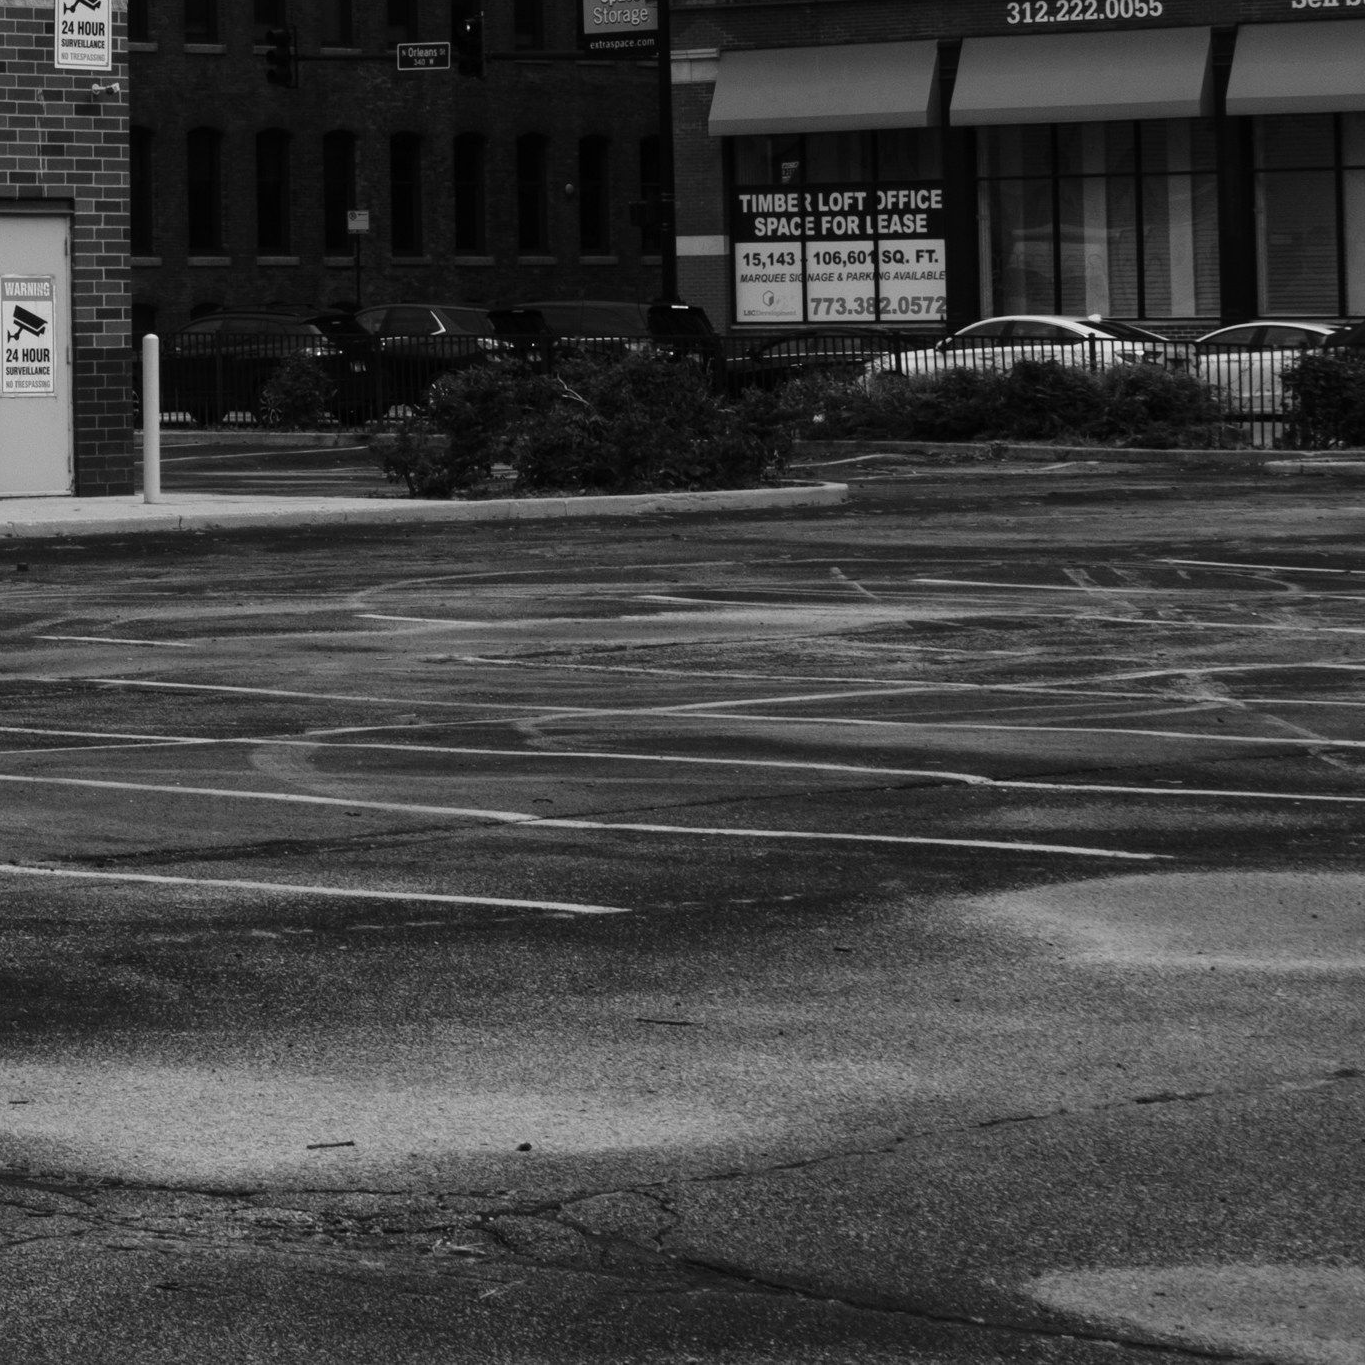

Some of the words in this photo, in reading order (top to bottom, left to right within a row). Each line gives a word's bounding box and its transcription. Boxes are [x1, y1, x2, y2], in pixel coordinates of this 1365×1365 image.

[594, 7, 648, 25] Storage
[62, 20, 74, 34] 24
[78, 21, 106, 36] HOUR
[61, 38, 105, 49] SURVEILLANCE
[590, 38, 655, 50] extraspace.com
[61, 52, 68, 60] NO
[70, 53, 106, 62] TRESPASSING
[408, 47, 438, 58] Orleans
[818, 192, 867, 212] LOFT
[877, 190, 942, 210] OFFICE
[754, 216, 815, 236] SPACE
[822, 216, 860, 236] FOR
[866, 213, 928, 234] LEASE
[743, 252, 795, 268] 15,143
[814, 250, 875, 268] 106,601
[882, 249, 909, 264] SQ.
[916, 249, 939, 263] FT.
[740, 273, 786, 283] MARQUEE
[788, 272, 834, 283] SIGNAGE
[836, 272, 843, 282] &
[893, 270, 946, 280] AVAILABLE
[4, 282, 50, 296] WARNING
[811, 296, 947, 315] 773.382.0572
[6, 348, 18, 362] 24
[22, 348, 50, 362] HOUR
[6, 366, 50, 375] SURVEILLANCE
[15, 380, 50, 388] TRESPASSING
